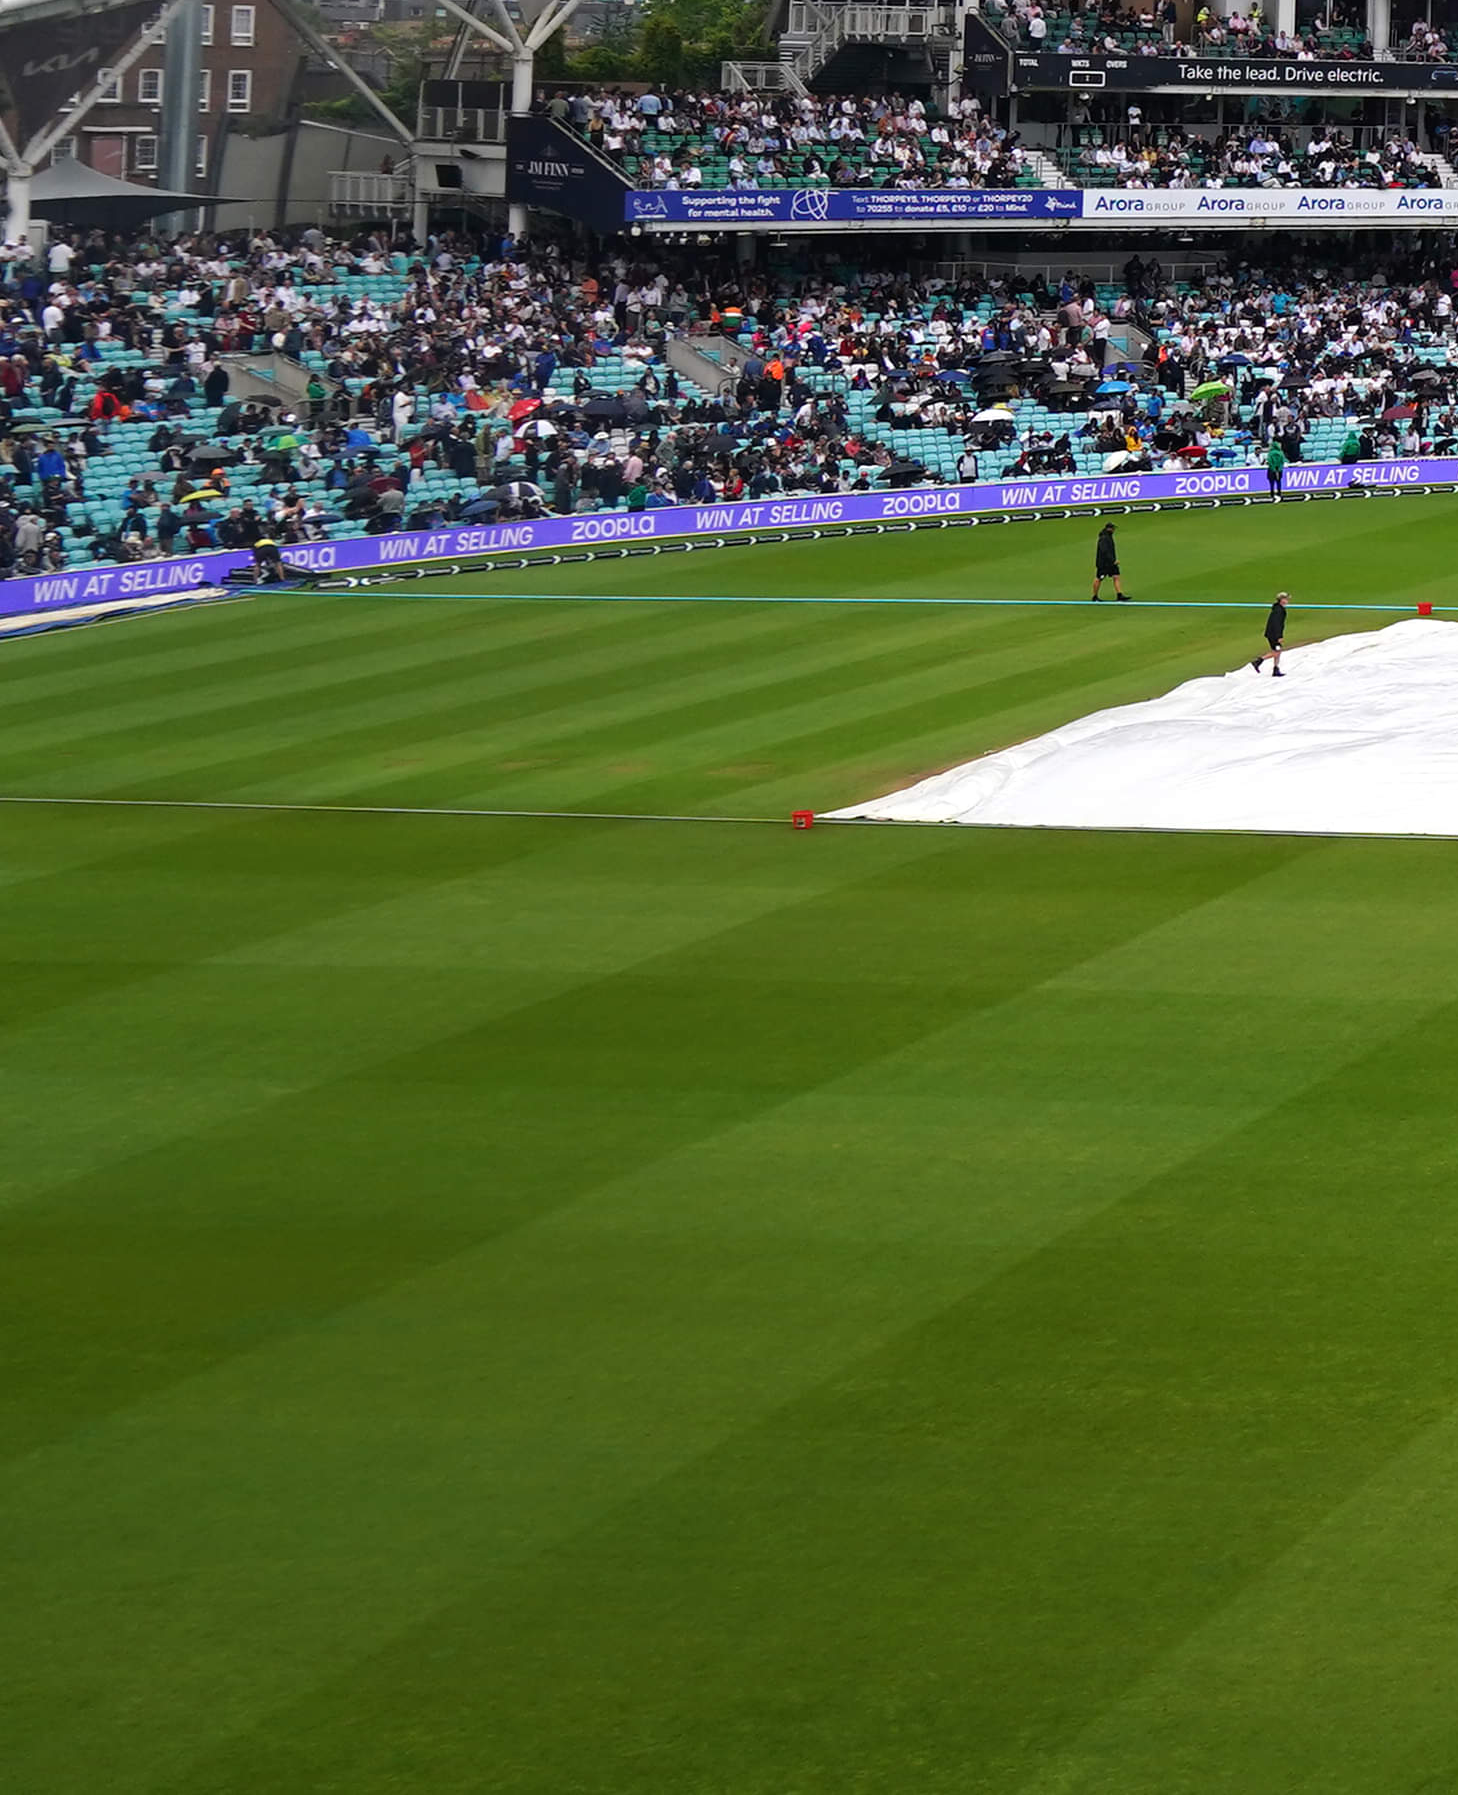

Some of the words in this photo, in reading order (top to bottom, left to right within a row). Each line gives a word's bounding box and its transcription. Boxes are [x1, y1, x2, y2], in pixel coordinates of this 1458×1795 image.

[1178, 65, 1215, 79] Take
[1218, 65, 1242, 80] the
[1245, 66, 1281, 81] lead.
[1285, 67, 1324, 81] Drive
[1327, 67, 1384, 83] electric.
[682, 196, 737, 207] Supporting
[739, 196, 756, 206] the
[1095, 196, 1145, 211] Arora
[1145, 202, 1187, 212] GROUP
[1197, 195, 1246, 211] Arora
[1246, 202, 1286, 212] GROUP
[1396, 195, 1444, 210] Arora
[687, 208, 702, 218] for
[704, 208, 739, 218] mental
[697, 510, 735, 530] WIN
[739, 508, 765, 526] AT
[770, 502, 843, 524] SELLING
[35, 579, 77, 603] WIN
[84, 574, 114, 597] AT
[119, 564, 204, 593] SELLING
